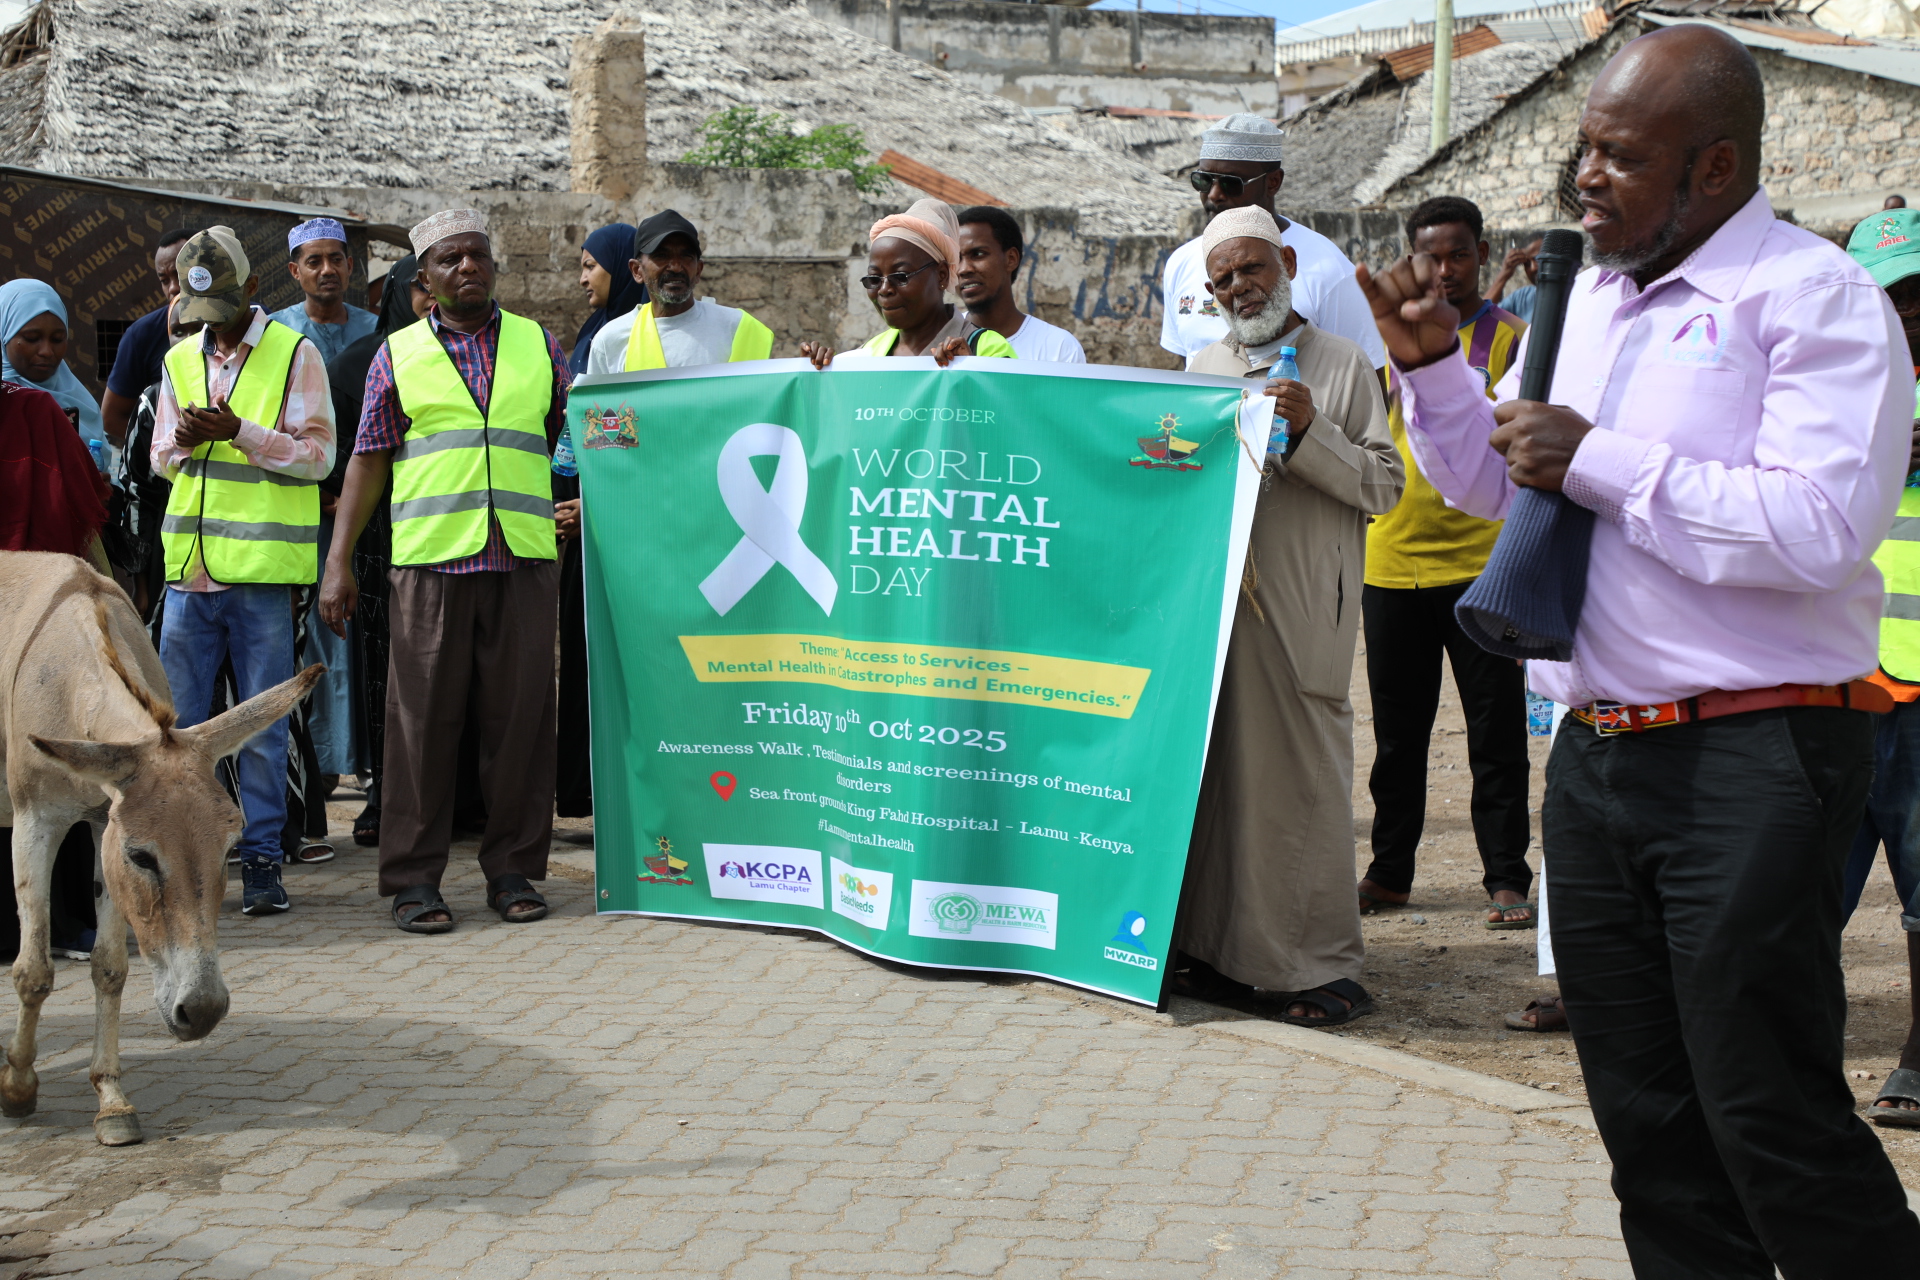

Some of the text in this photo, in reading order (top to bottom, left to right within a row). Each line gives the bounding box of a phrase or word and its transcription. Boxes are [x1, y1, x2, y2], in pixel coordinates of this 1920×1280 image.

[45, 209, 108, 259] THRIVE
[1875, 235, 1910, 250] ARIEL
[65, 236, 128, 285] THRIVE
[85, 263, 148, 313] THRIVE
[854, 407, 996, 424] 10TH OCTOBER
[851, 448, 1042, 485] WORLD
[849, 486, 1061, 529] MENTAL
[849, 525, 1050, 567] HEALTH
[850, 564, 932, 597] DAY
[799, 641, 840, 658] Theme:
[903, 653, 916, 666] to
[919, 653, 1012, 673] Services
[707, 660, 773, 673] Mental
[778, 660, 826, 675] Health
[828, 663, 837, 676] in
[837, 666, 927, 687] Catastrophes
[933, 677, 978, 690] and
[741, 702, 833, 734] Friday
[835, 708, 861, 733] 10th
[918, 724, 1007, 752] 2025
[657, 740, 754, 754] Awareness
[757, 742, 804, 757] Walk
[812, 744, 883, 771] Testimonials
[887, 761, 912, 775] and
[913, 764, 1039, 788] screenings
[1043, 776, 1063, 789] of
[1064, 780, 1132, 802] mental
[836, 772, 892, 793] disorders
[749, 788, 780, 800] Sea
[782, 788, 818, 803] front
[819, 794, 847, 812] grounds
[847, 802, 876, 822] King
[879, 807, 910, 824] Fahd
[911, 812, 1000, 832] Hospital
[1019, 821, 1070, 842] Lamu
[1073, 832, 1135, 855] -Kenya
[746, 862, 812, 882] KCPA
[750, 881, 775, 889] Lamu
[777, 883, 810, 894] Chapter
[986, 904, 1046, 923] MEWA
[1105, 948, 1155, 967] MWARP
